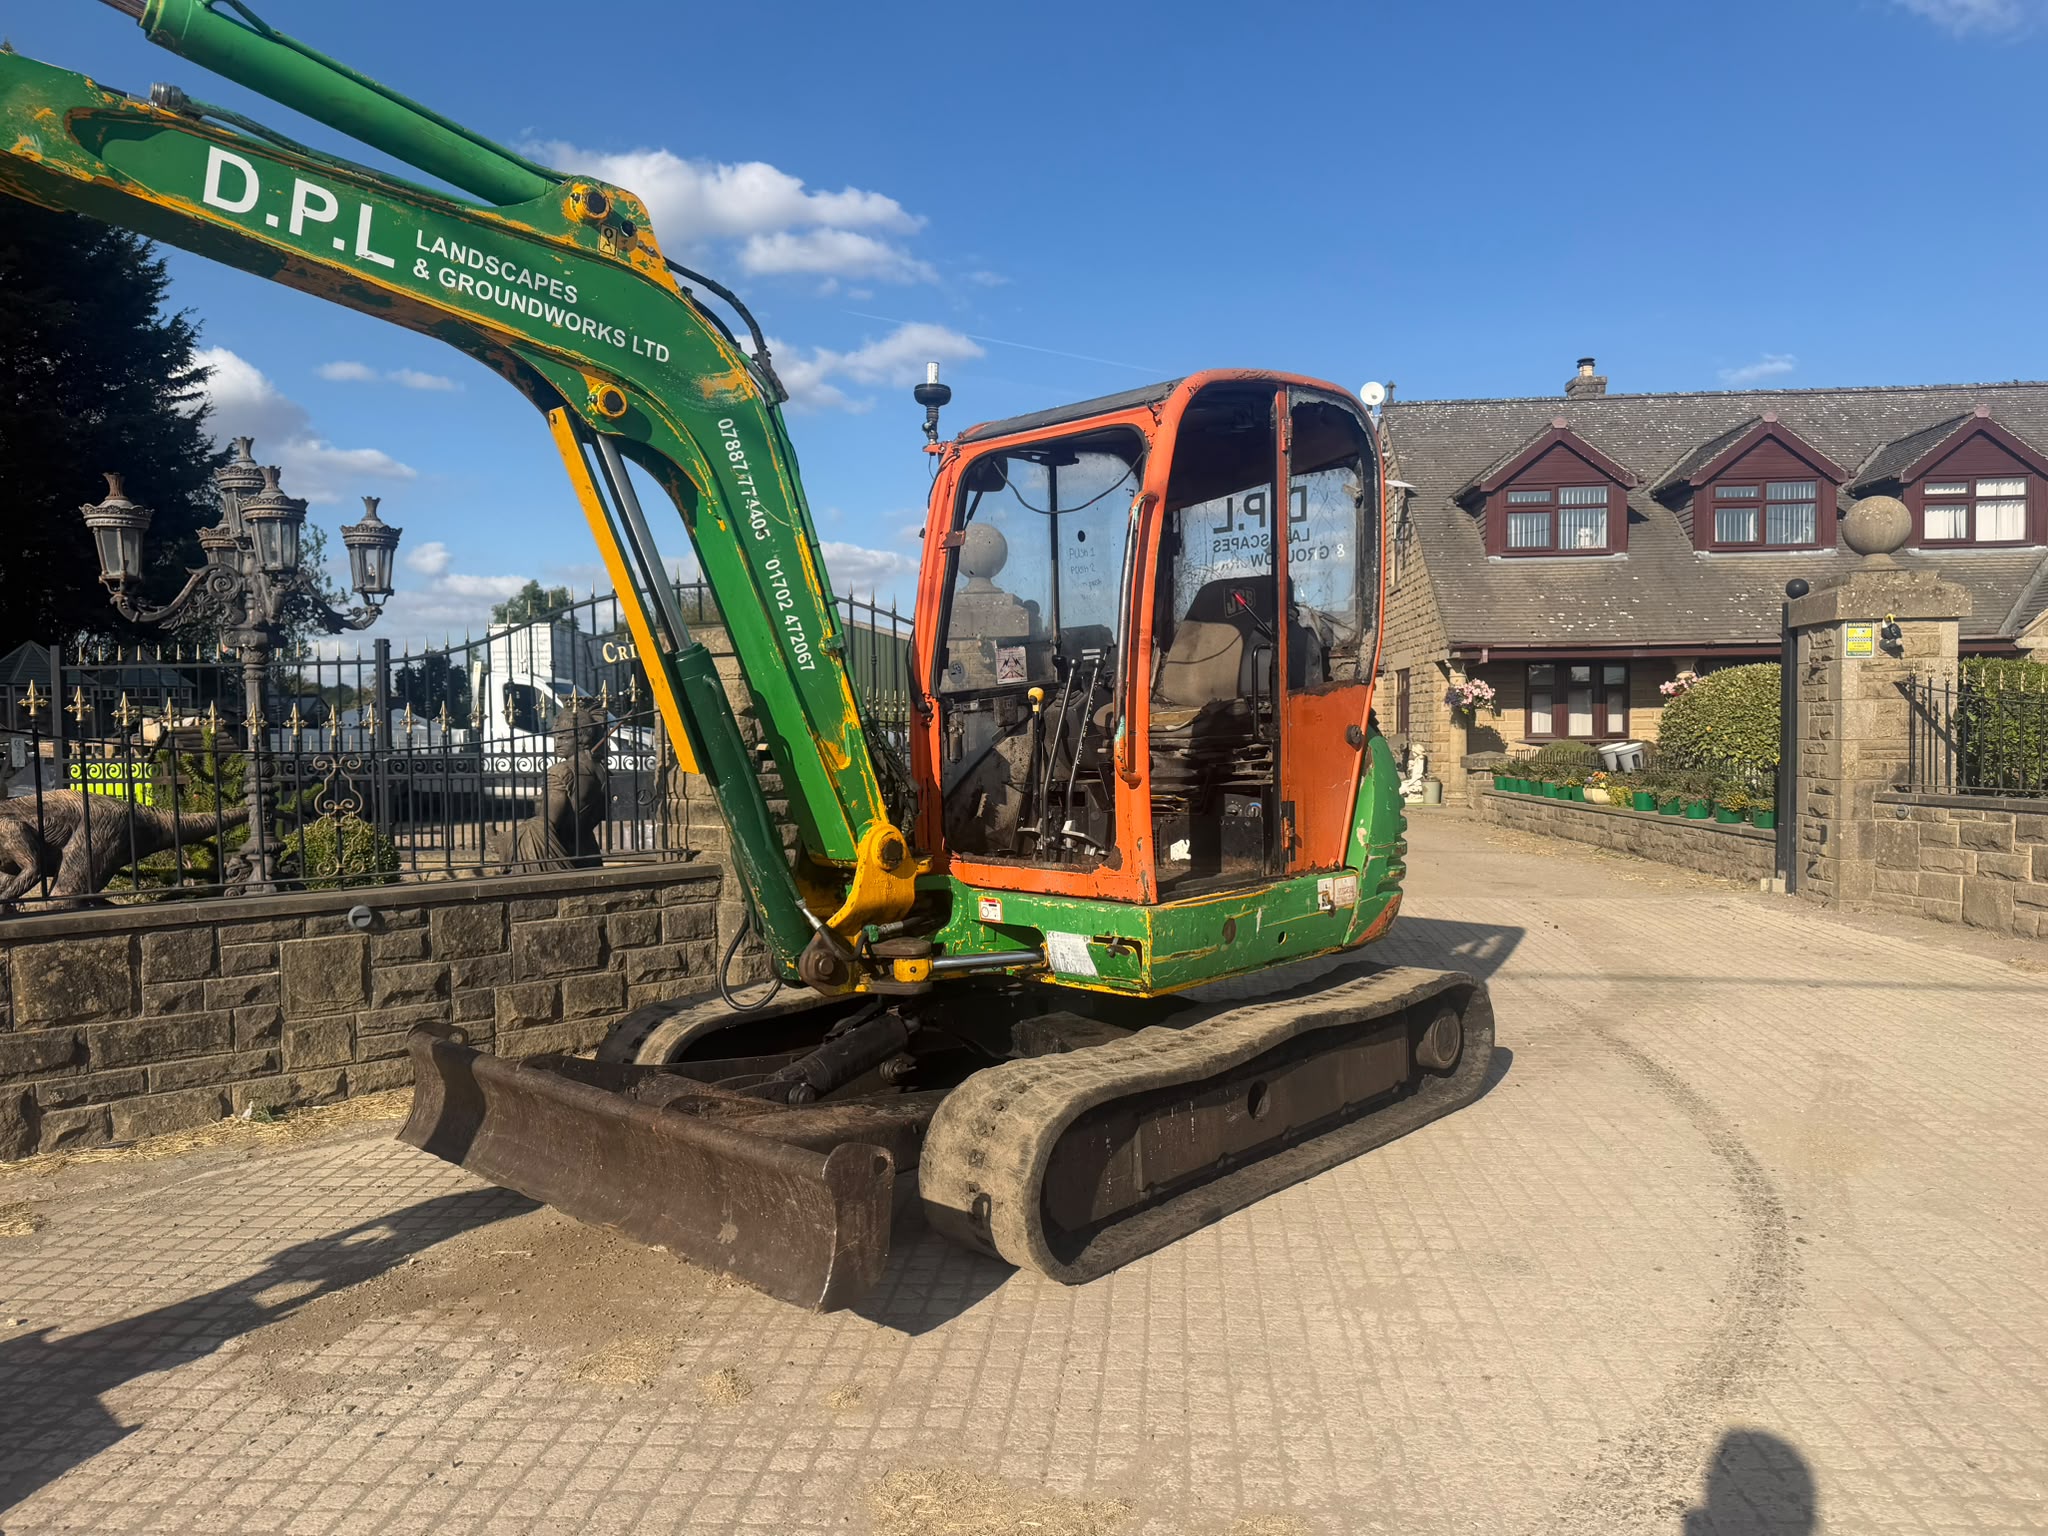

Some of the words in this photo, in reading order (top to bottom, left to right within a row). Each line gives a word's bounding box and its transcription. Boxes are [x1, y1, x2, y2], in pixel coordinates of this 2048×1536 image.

[203, 145, 395, 269] D.P.L
[413, 257, 430, 281] &
[438, 267, 626, 348] GROUNDWORKS
[632, 335, 670, 363] LTD
[415, 229, 578, 304] LANDSCAPES
[718, 418, 748, 471] 07887
[765, 558, 794, 611] 01702
[784, 614, 816, 672] 472067
